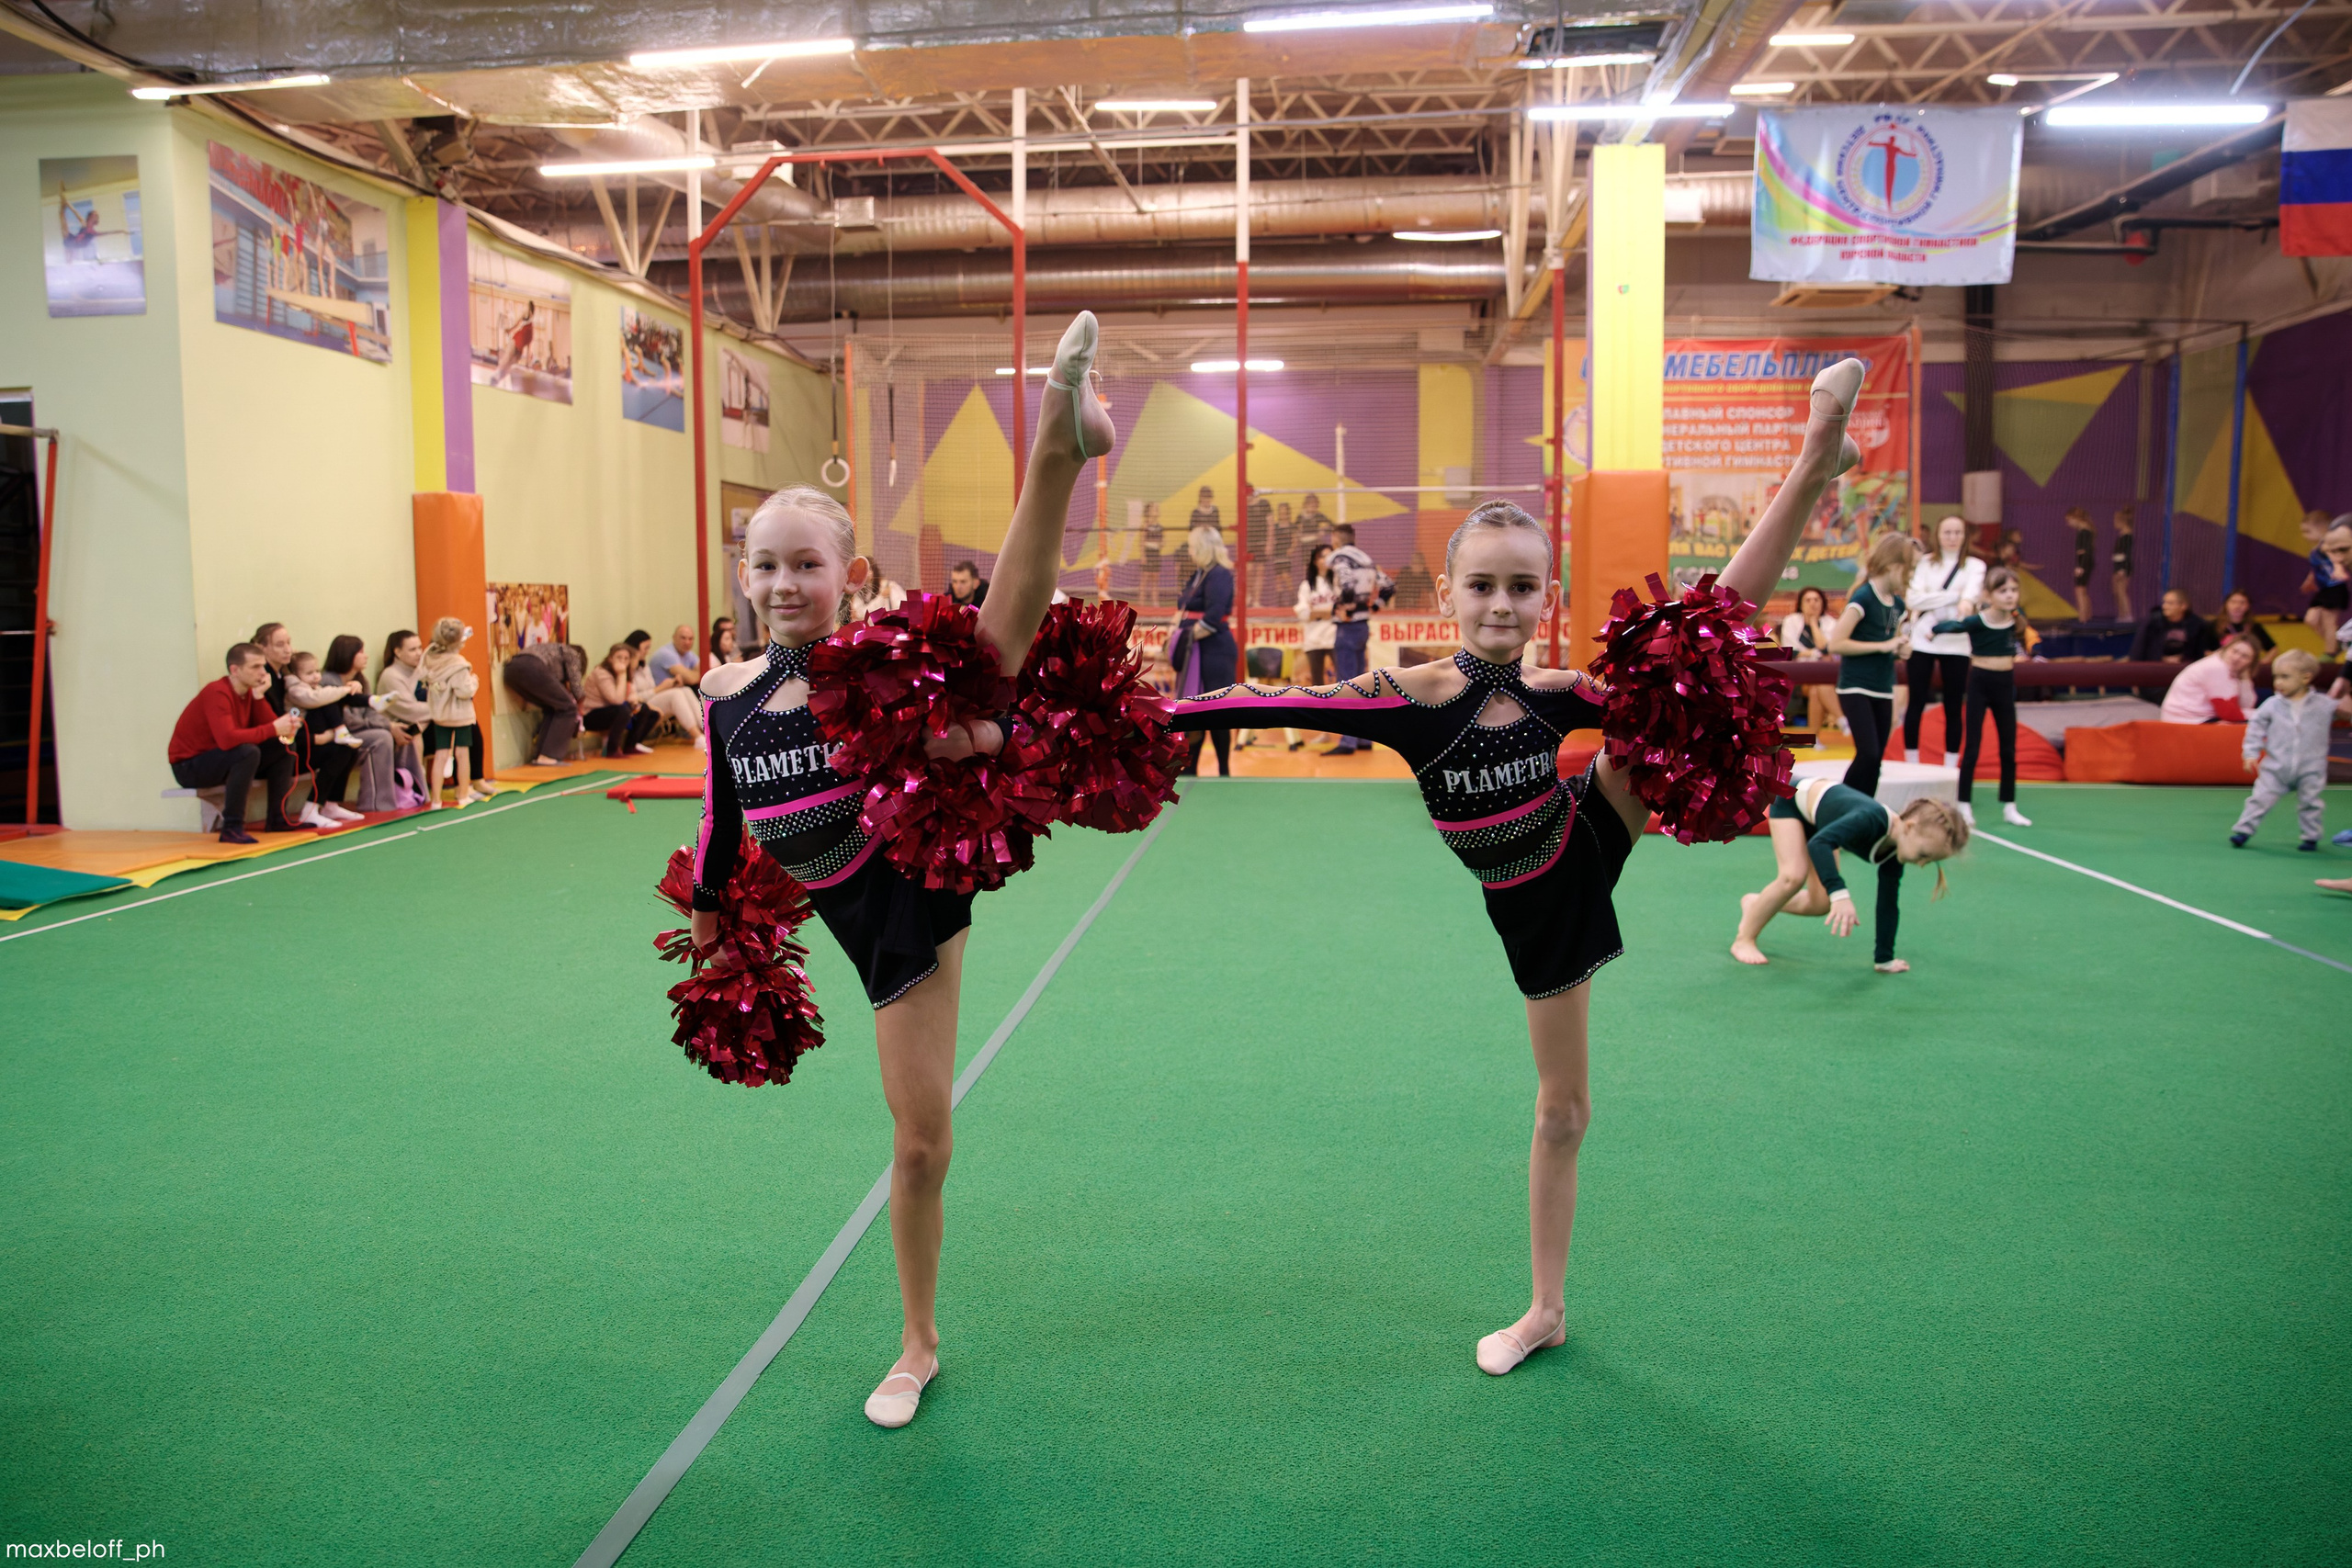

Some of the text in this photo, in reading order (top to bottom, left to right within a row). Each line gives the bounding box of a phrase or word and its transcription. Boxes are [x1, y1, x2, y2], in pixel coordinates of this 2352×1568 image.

[1663, 404, 1795, 420] ЛАВНЫЙ СПОНСОР
[1752, 422, 1807, 435] ПАРТНЕ
[1735, 438, 1792, 455] ЦЕНТРА
[1380, 622, 1461, 641] ВЫРАСТ
[733, 741, 841, 784] PLAMETR
